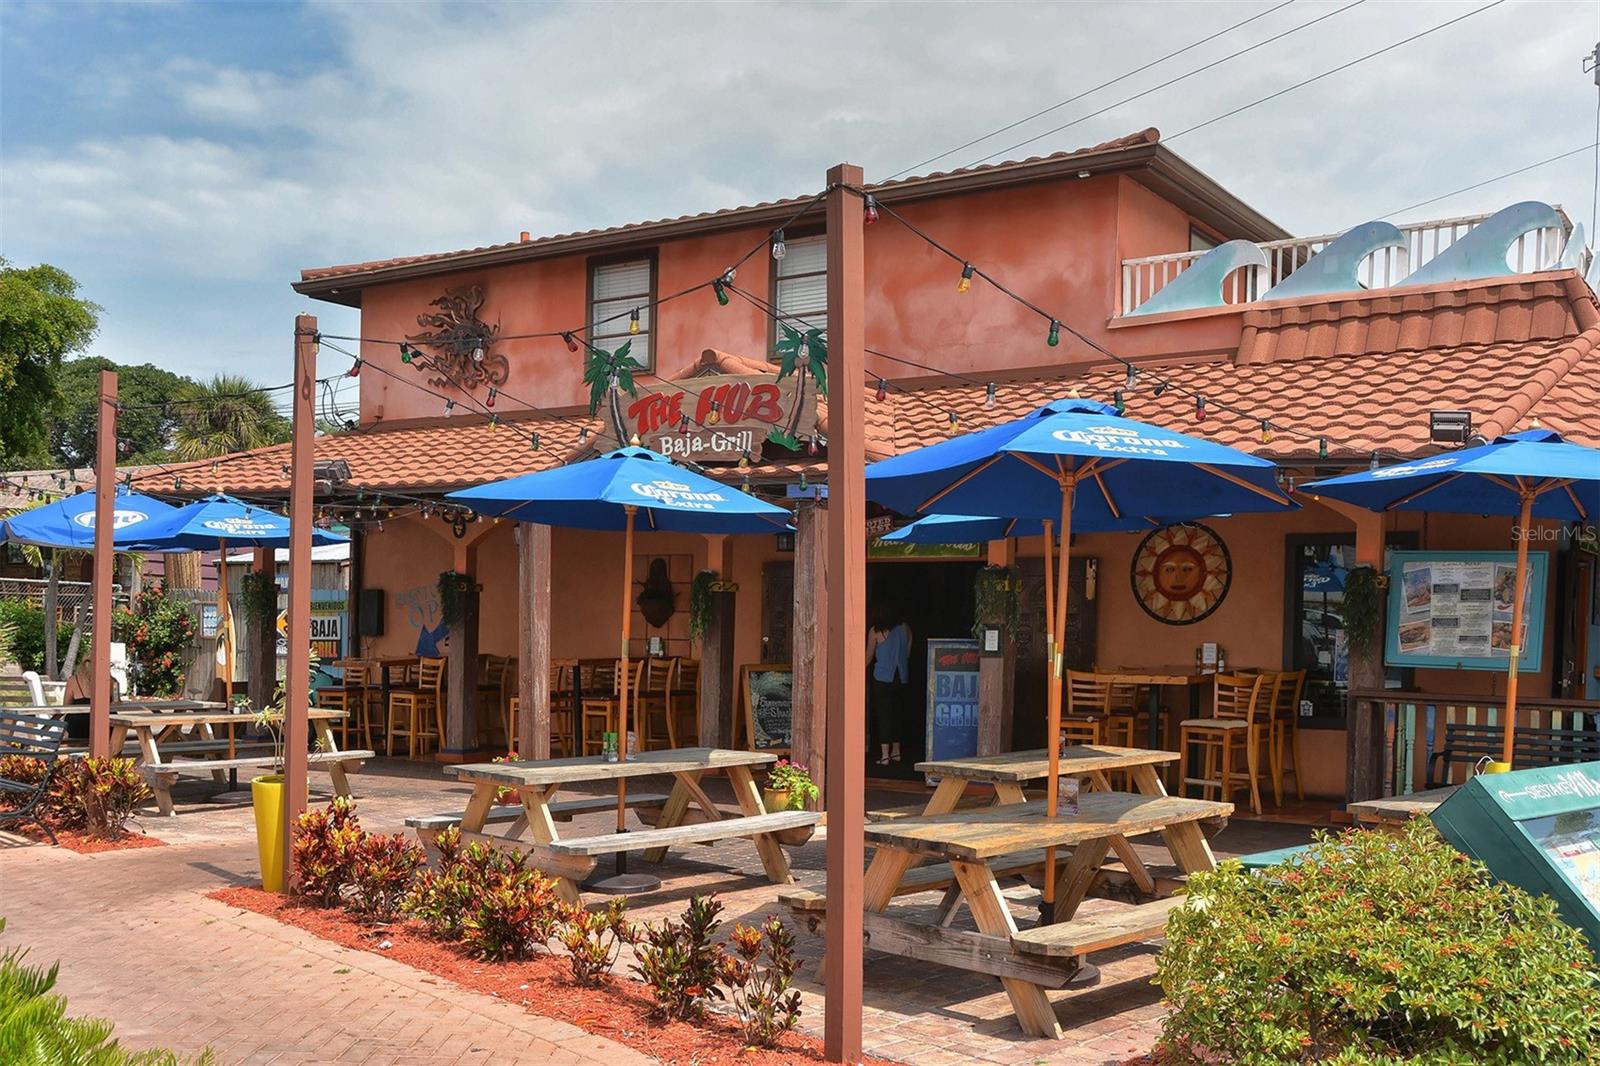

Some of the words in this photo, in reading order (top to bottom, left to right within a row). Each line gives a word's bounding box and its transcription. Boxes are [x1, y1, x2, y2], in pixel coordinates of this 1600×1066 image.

[628, 391, 685, 434] THE
[696, 382, 785, 427] HUB
[659, 431, 753, 458] Baja-Grill
[1052, 429, 1184, 449] Corona
[1096, 441, 1169, 456] Extra
[630, 483, 724, 502] Corona
[664, 497, 715, 509] Extra
[311, 619, 338, 637] BAJA
[936, 674, 979, 699] BAJ
